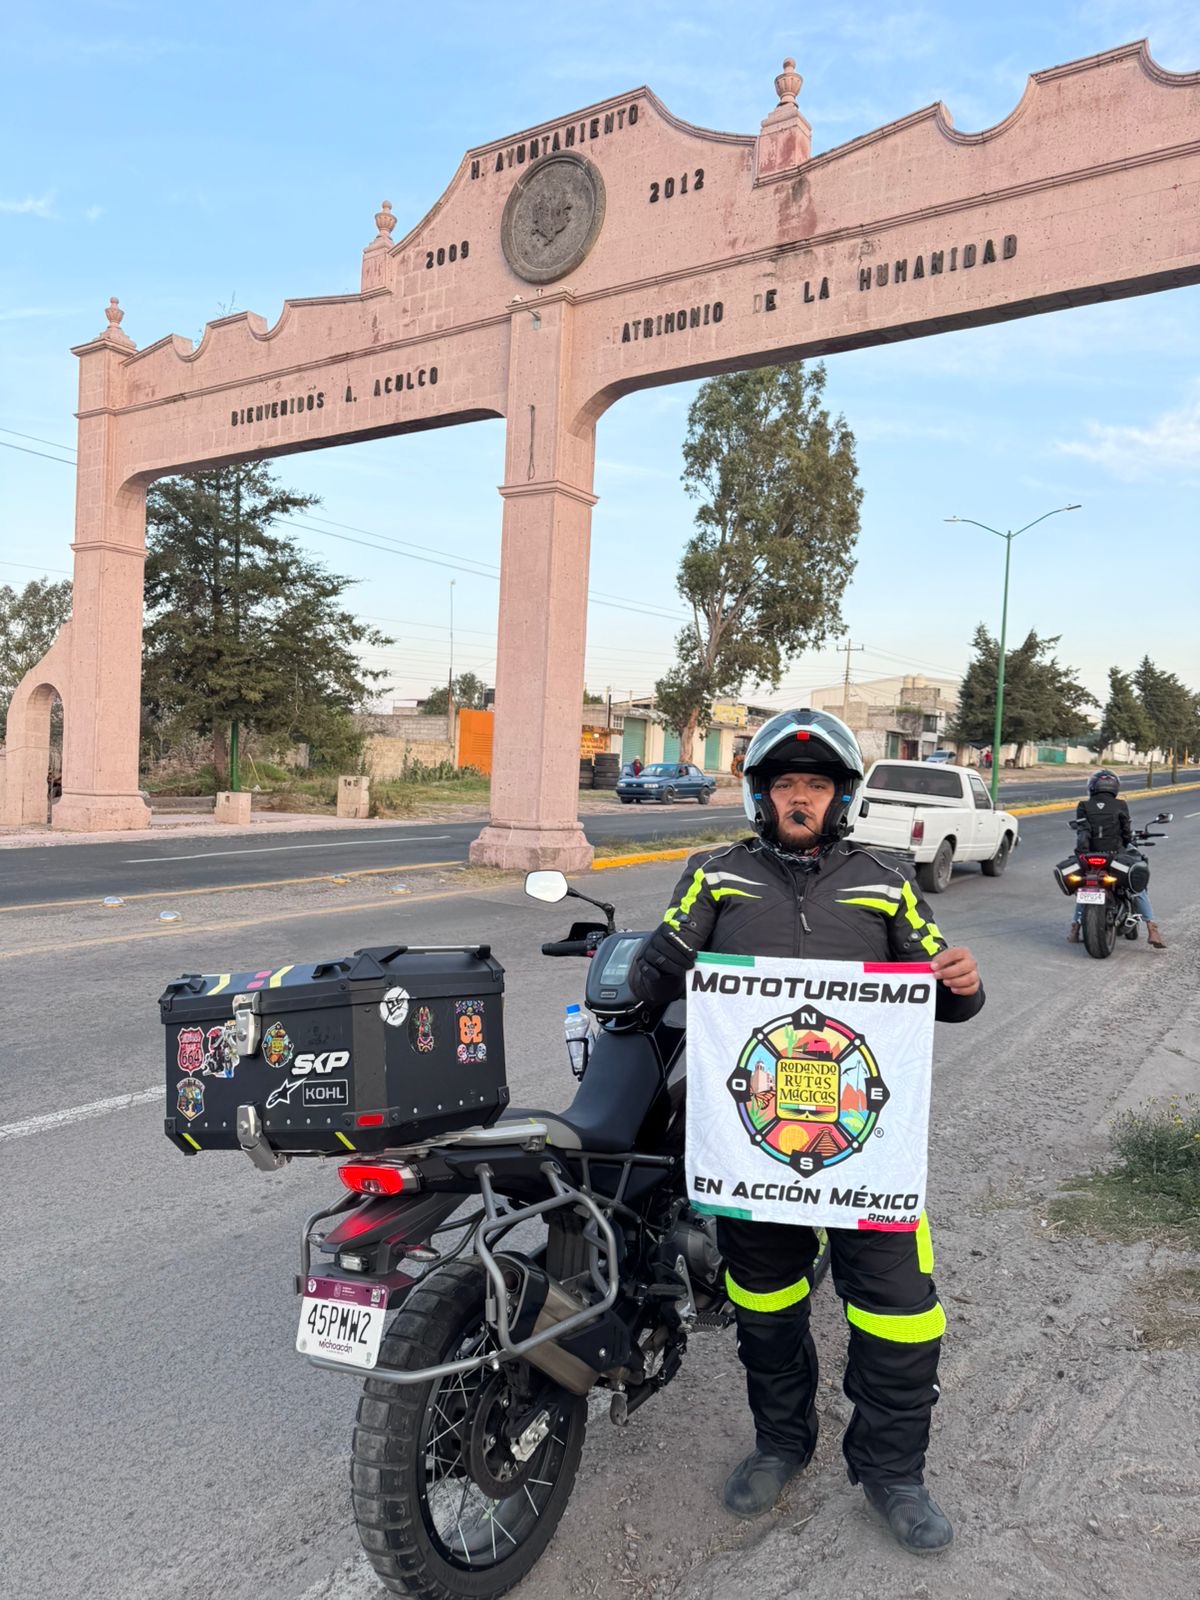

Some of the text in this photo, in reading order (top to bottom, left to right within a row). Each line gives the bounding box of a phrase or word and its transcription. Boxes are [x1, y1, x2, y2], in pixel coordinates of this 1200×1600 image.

[495, 103, 639, 172] AYUNTAMIENTO
[649, 168, 705, 203] 2012
[425, 240, 469, 269] 2009
[803, 276, 829, 303] LA
[859, 233, 1018, 292] HUMANIDAD
[231, 391, 325, 427] BIENVENIDOS
[373, 366, 439, 397] ACULCO
[691, 970, 931, 1004] MOTOTURISMO
[800, 1011, 817, 1026] N
[291, 1050, 350, 1075] SKP
[305, 1086, 345, 1100] KOHL
[732, 1078, 747, 1091] O
[870, 1087, 884, 1101] E
[799, 1156, 814, 1171] S
[694, 1175, 919, 1210] EN ACCIÓN MÉXICO
[307, 1303, 372, 1345] 45PMW2
[318, 1338, 353, 1354] Michoacán
